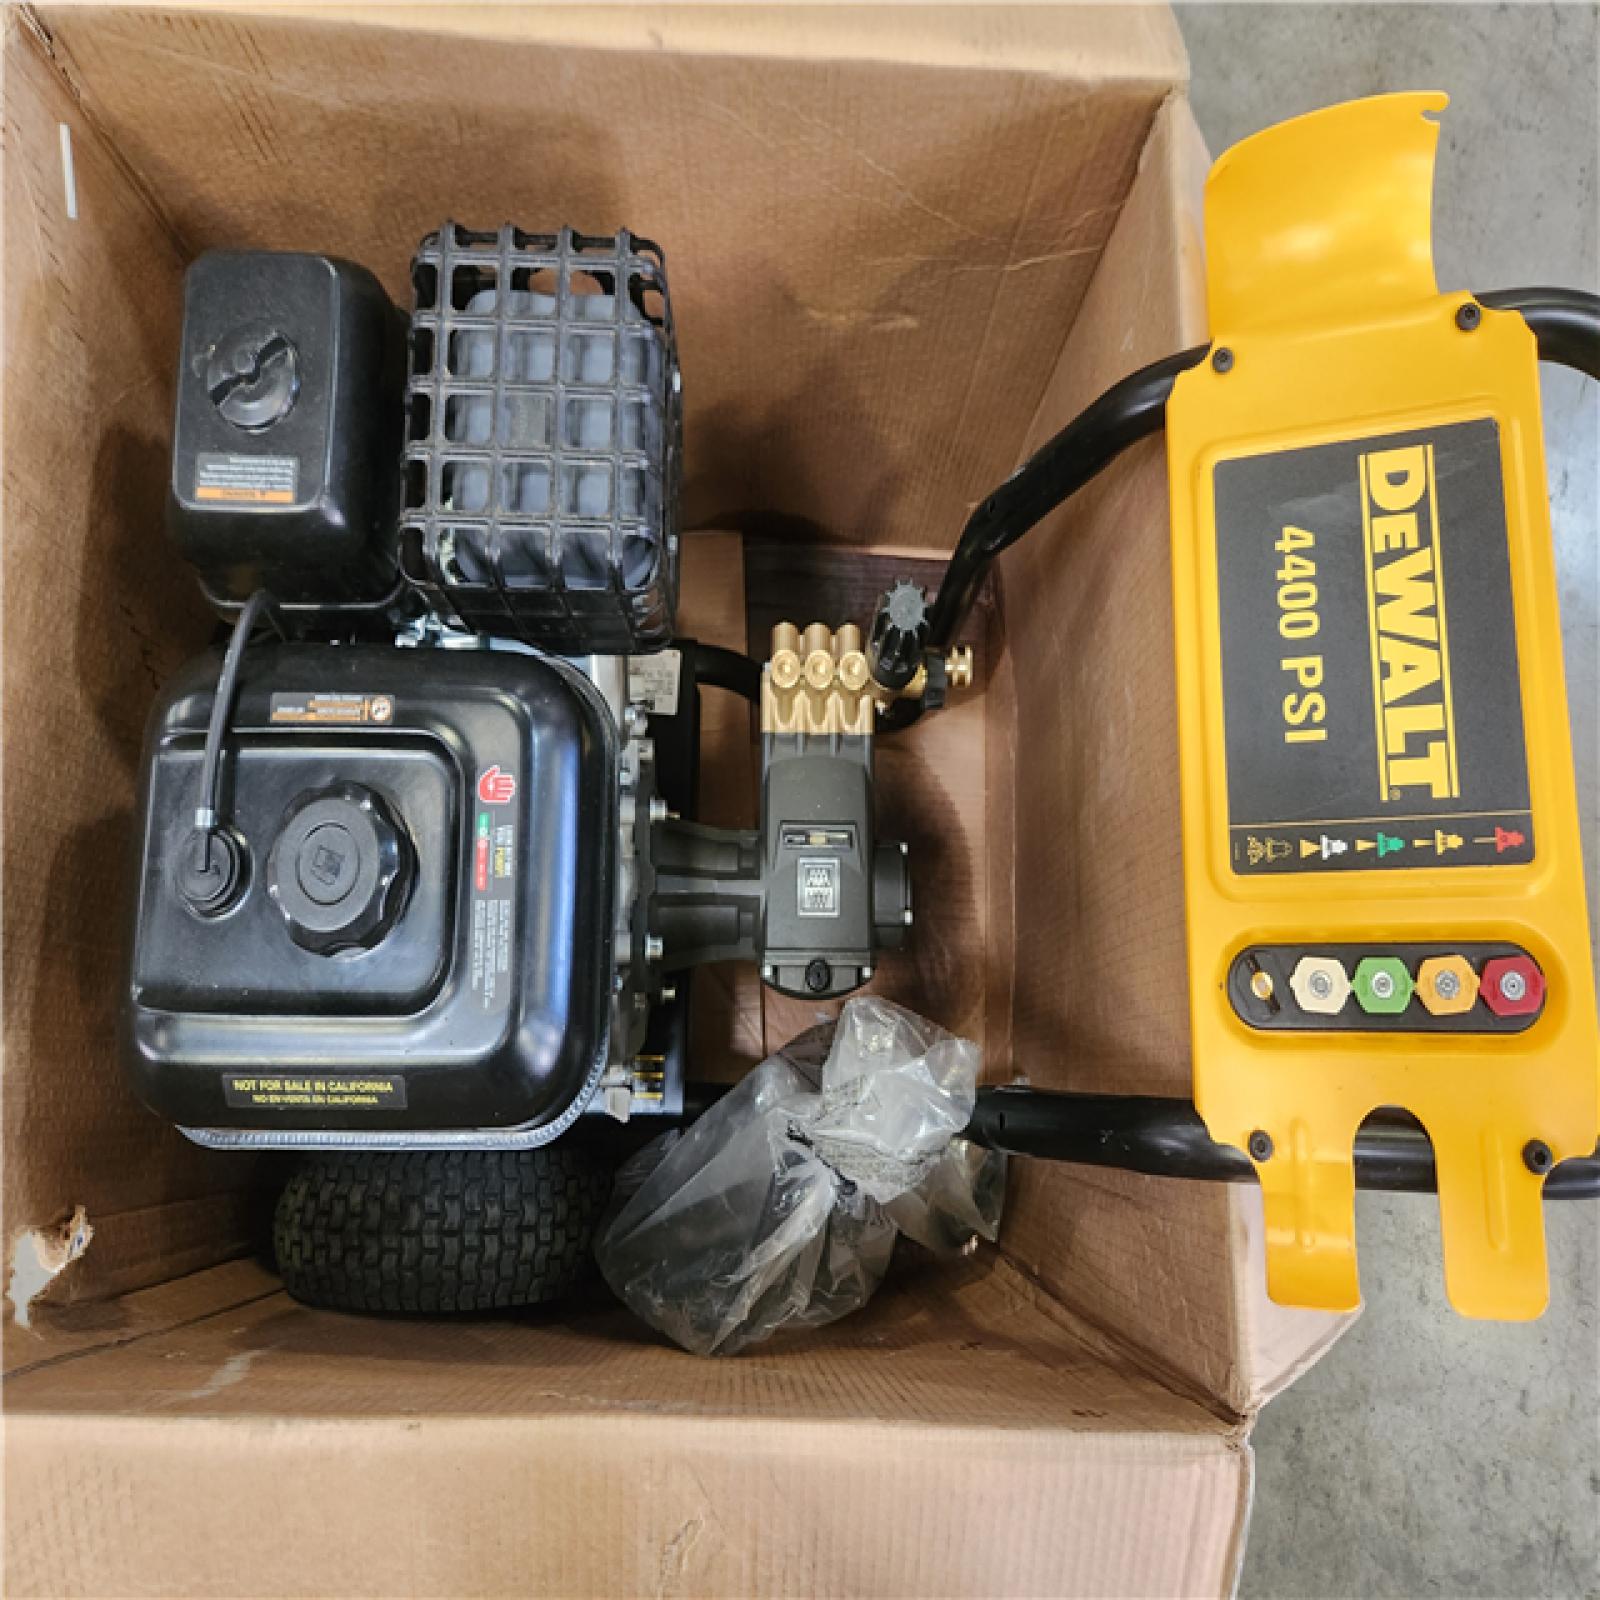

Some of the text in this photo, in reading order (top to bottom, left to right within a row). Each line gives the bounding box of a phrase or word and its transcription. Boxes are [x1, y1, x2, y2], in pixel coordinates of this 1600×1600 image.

[1274, 524, 1328, 743] 4400 PSI
[1366, 445, 1453, 799] DEWALT
[233, 1079, 394, 1093] NOT FOR SALE IN CALIFORNIA
